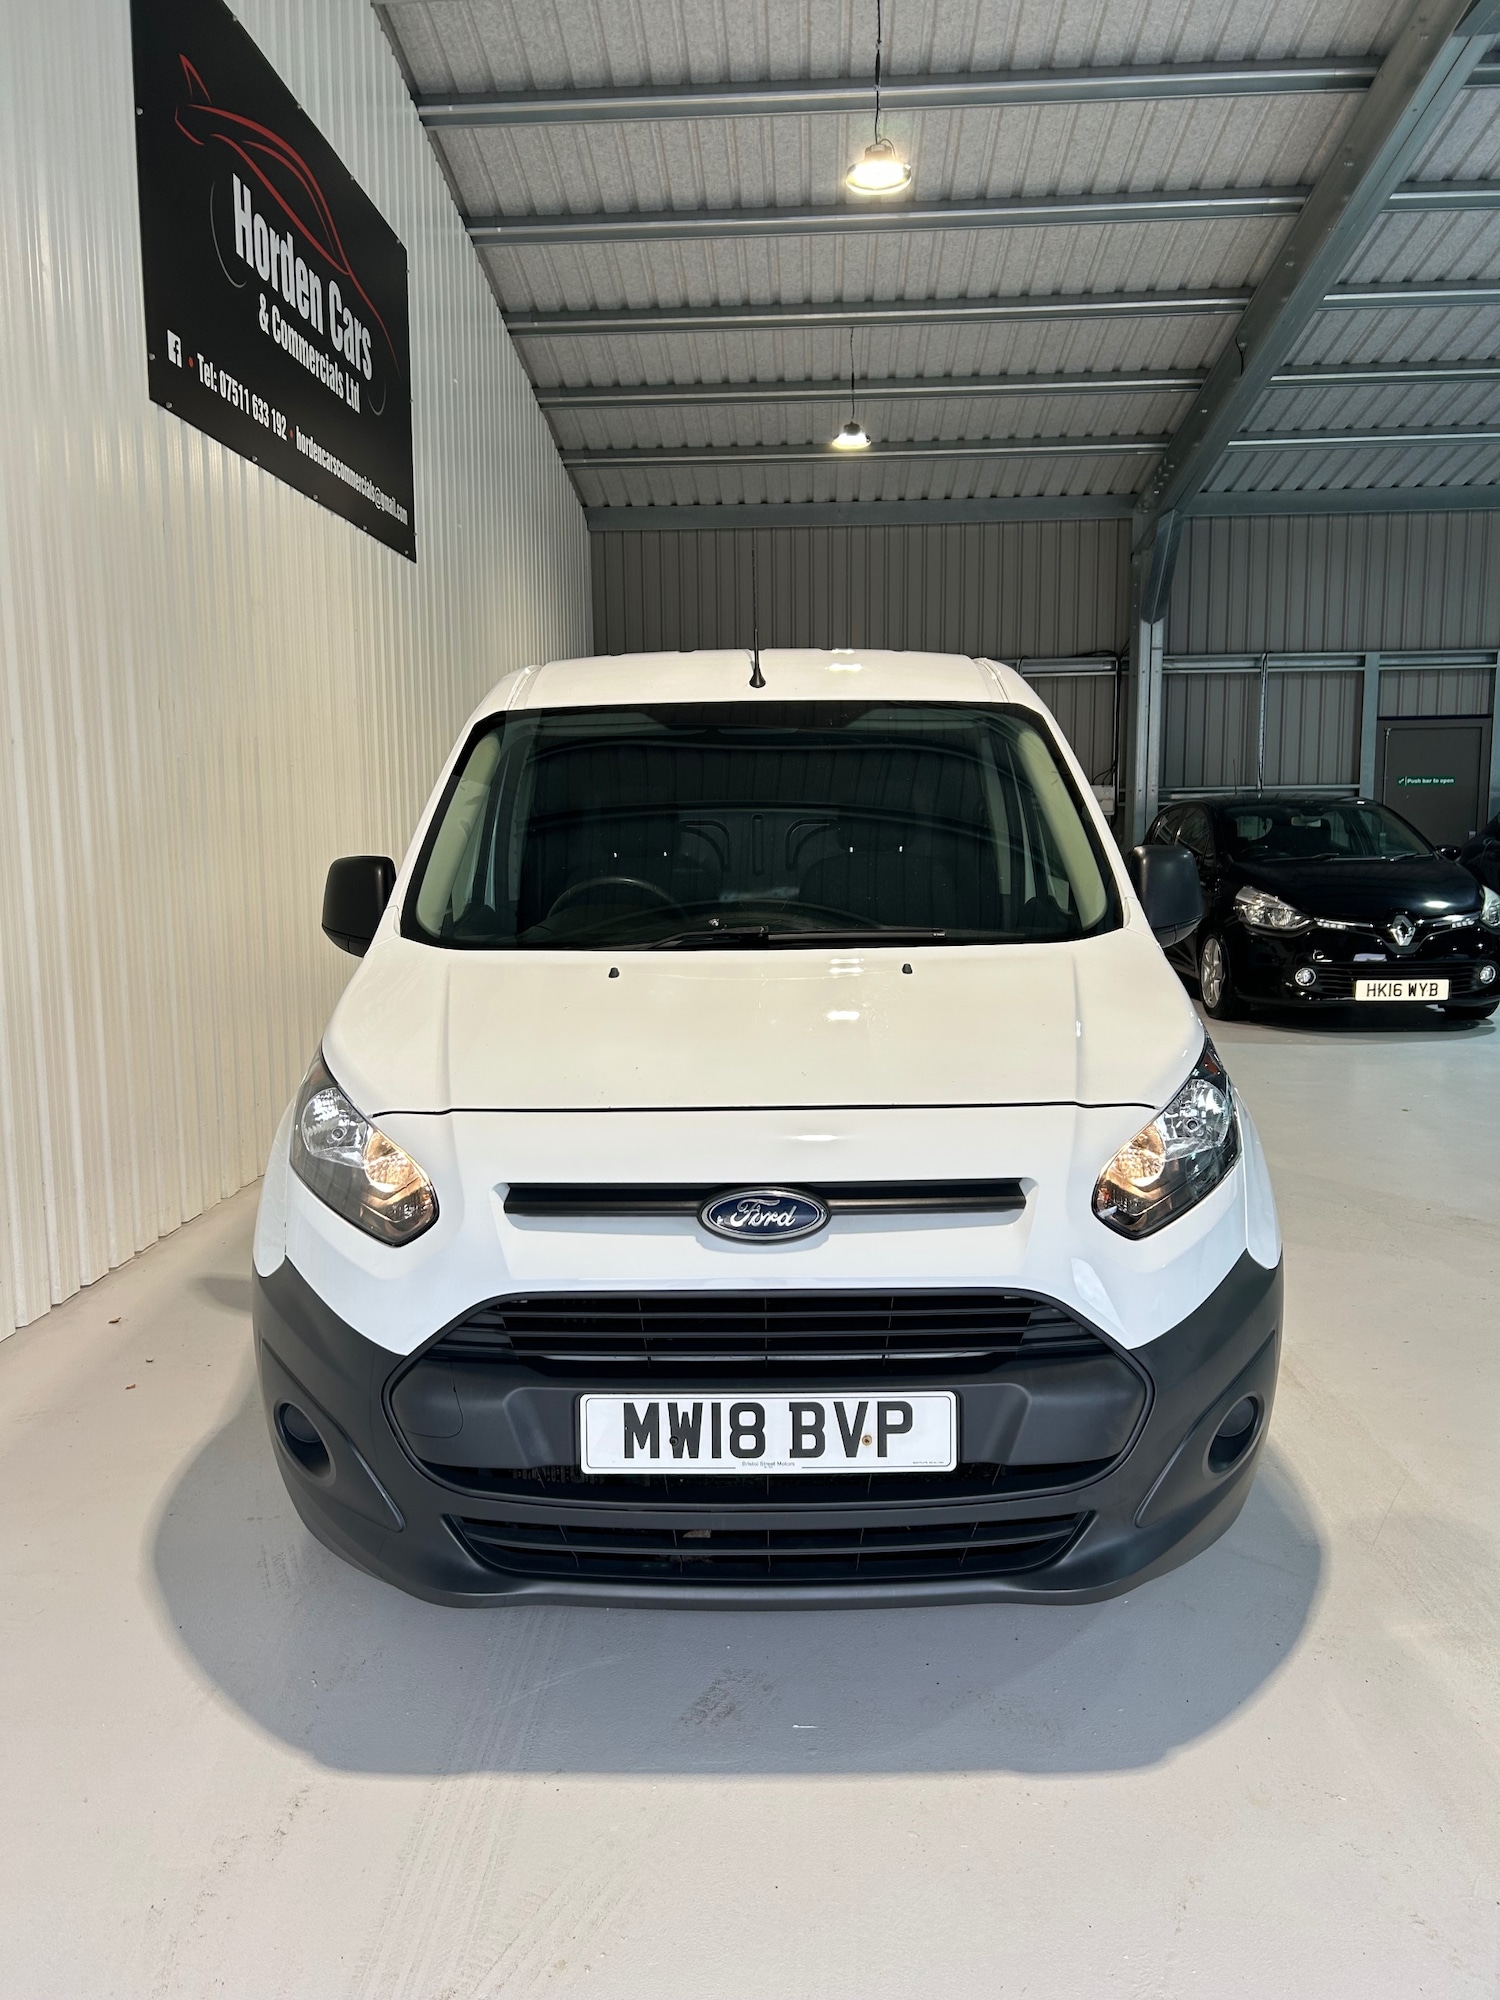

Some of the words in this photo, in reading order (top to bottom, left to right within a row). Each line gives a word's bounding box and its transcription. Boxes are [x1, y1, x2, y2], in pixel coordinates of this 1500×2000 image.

[232, 172, 324, 335] Horden
[328, 279, 373, 381] Cars
[259, 292, 270, 335] &
[271, 304, 345, 400] Commercials
[345, 371, 361, 414] Ltd
[197, 352, 218, 393] Tel:
[219, 369, 250, 415] 07511
[251, 393, 270, 428] 633
[271, 407, 288, 441] 192
[1366, 983, 1403, 997] HK16
[1408, 982, 1439, 997] WYB
[729, 1198, 798, 1227] Ford
[623, 1401, 766, 1459] MW18
[789, 1400, 914, 1458] BVP
